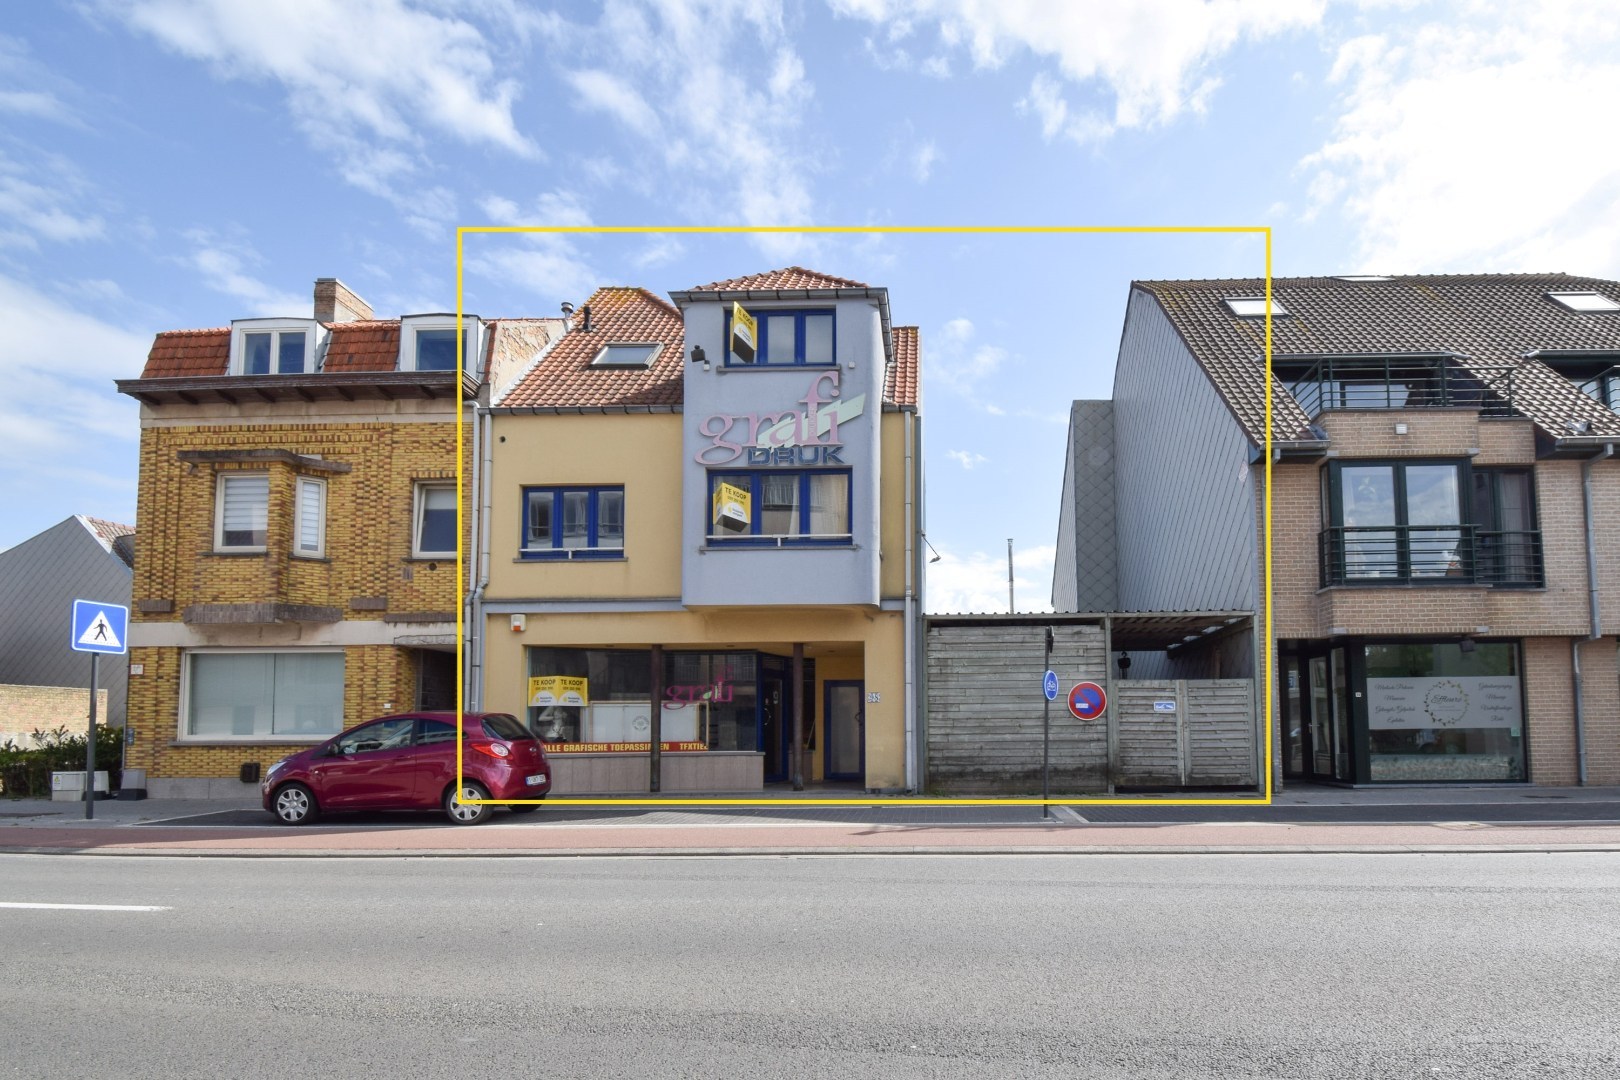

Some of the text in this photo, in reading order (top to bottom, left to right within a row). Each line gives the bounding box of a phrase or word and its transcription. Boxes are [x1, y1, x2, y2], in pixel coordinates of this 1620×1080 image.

[695, 371, 844, 465] grafi
[747, 446, 845, 465] DRUK
[732, 490, 747, 500] KOOP
[610, 743, 670, 751] TOEPASSIEN
